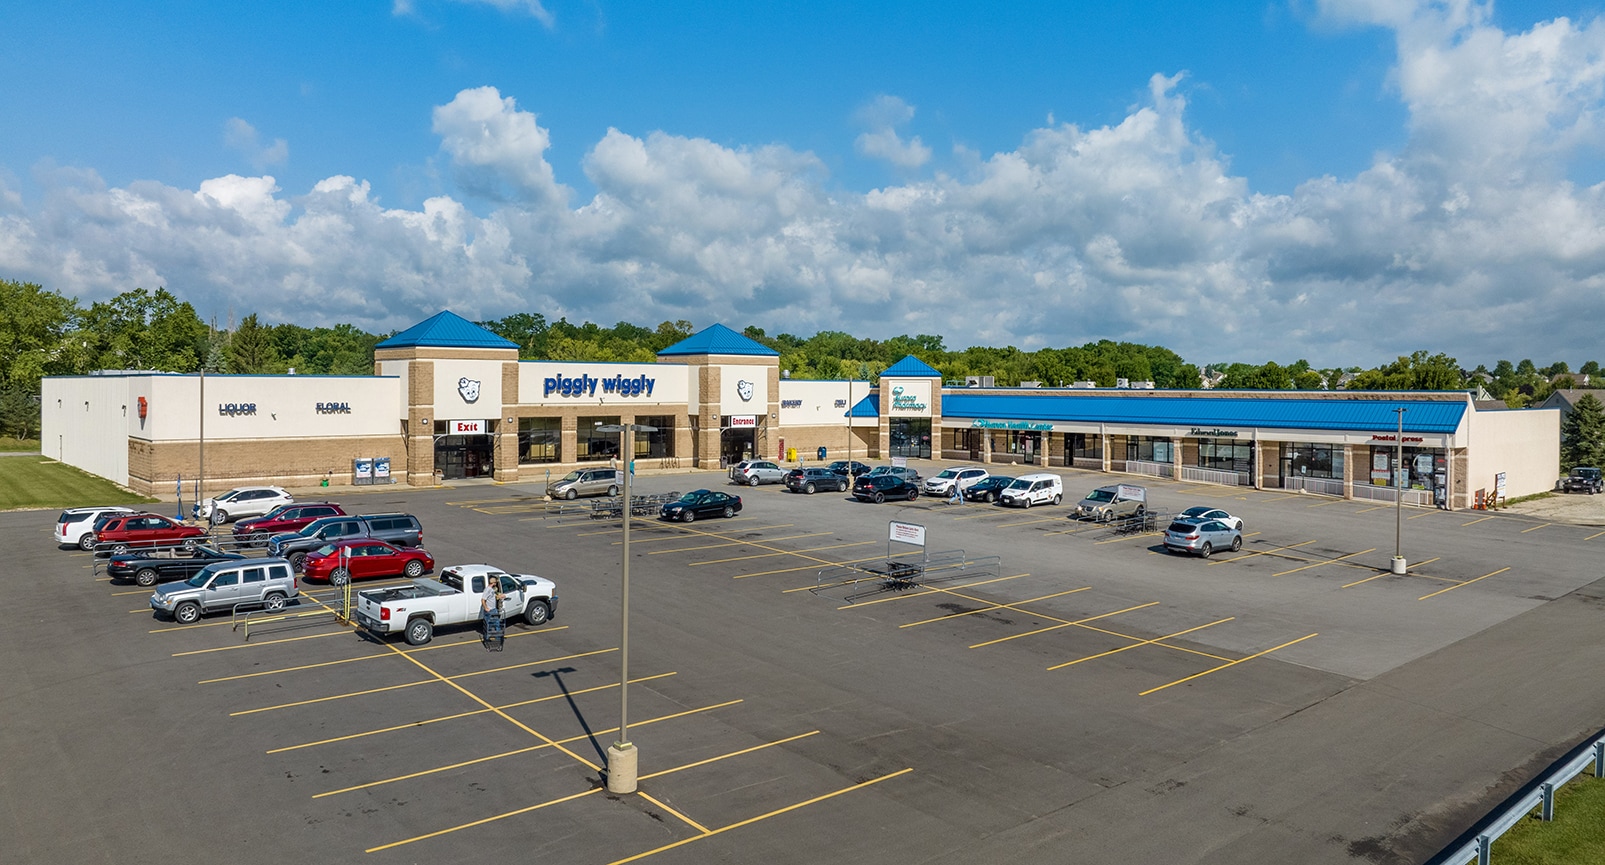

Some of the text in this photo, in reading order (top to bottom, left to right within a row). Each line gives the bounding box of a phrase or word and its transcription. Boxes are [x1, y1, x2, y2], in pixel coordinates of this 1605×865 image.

[544, 373, 655, 396] piggly wiggly
[218, 403, 257, 414] LIQUOR
[315, 402, 351, 412] FLORAL
[732, 417, 755, 426] Entrance
[457, 422, 478, 432] Exit
